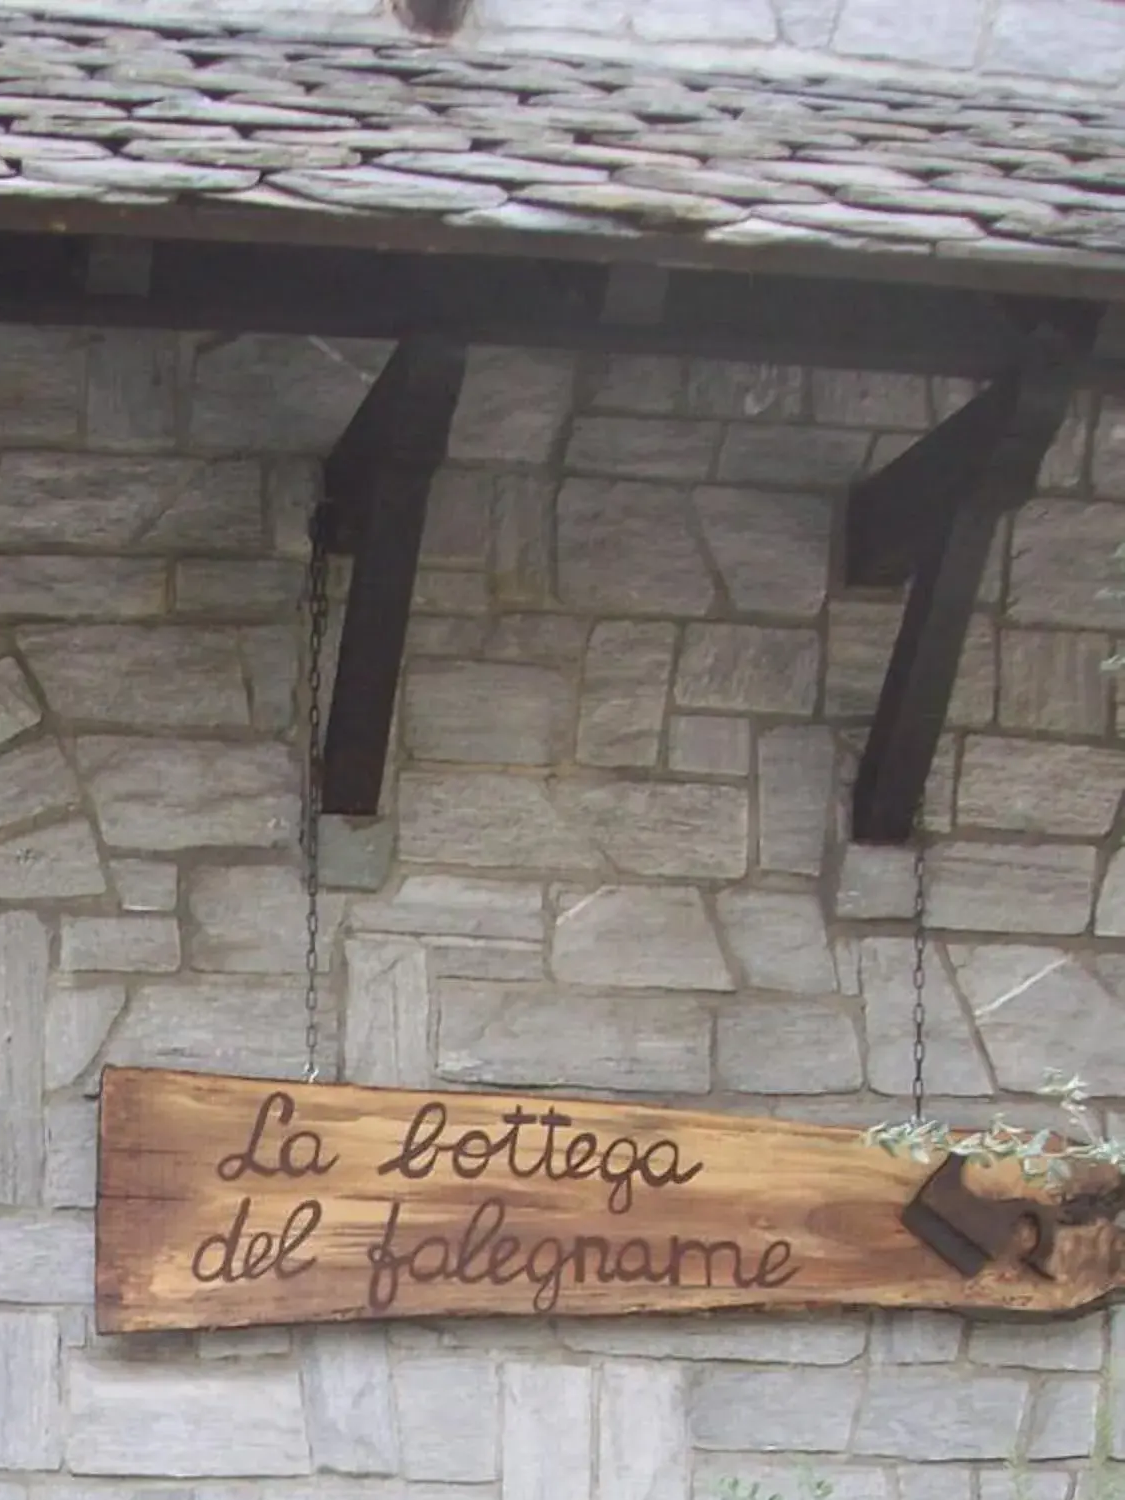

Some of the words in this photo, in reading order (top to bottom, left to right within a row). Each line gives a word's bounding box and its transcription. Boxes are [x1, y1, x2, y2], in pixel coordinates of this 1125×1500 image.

[216, 1092, 339, 1182] La
[378, 1102, 703, 1213] bottega
[192, 1197, 322, 1283] del
[368, 1201, 800, 1311] falegname
